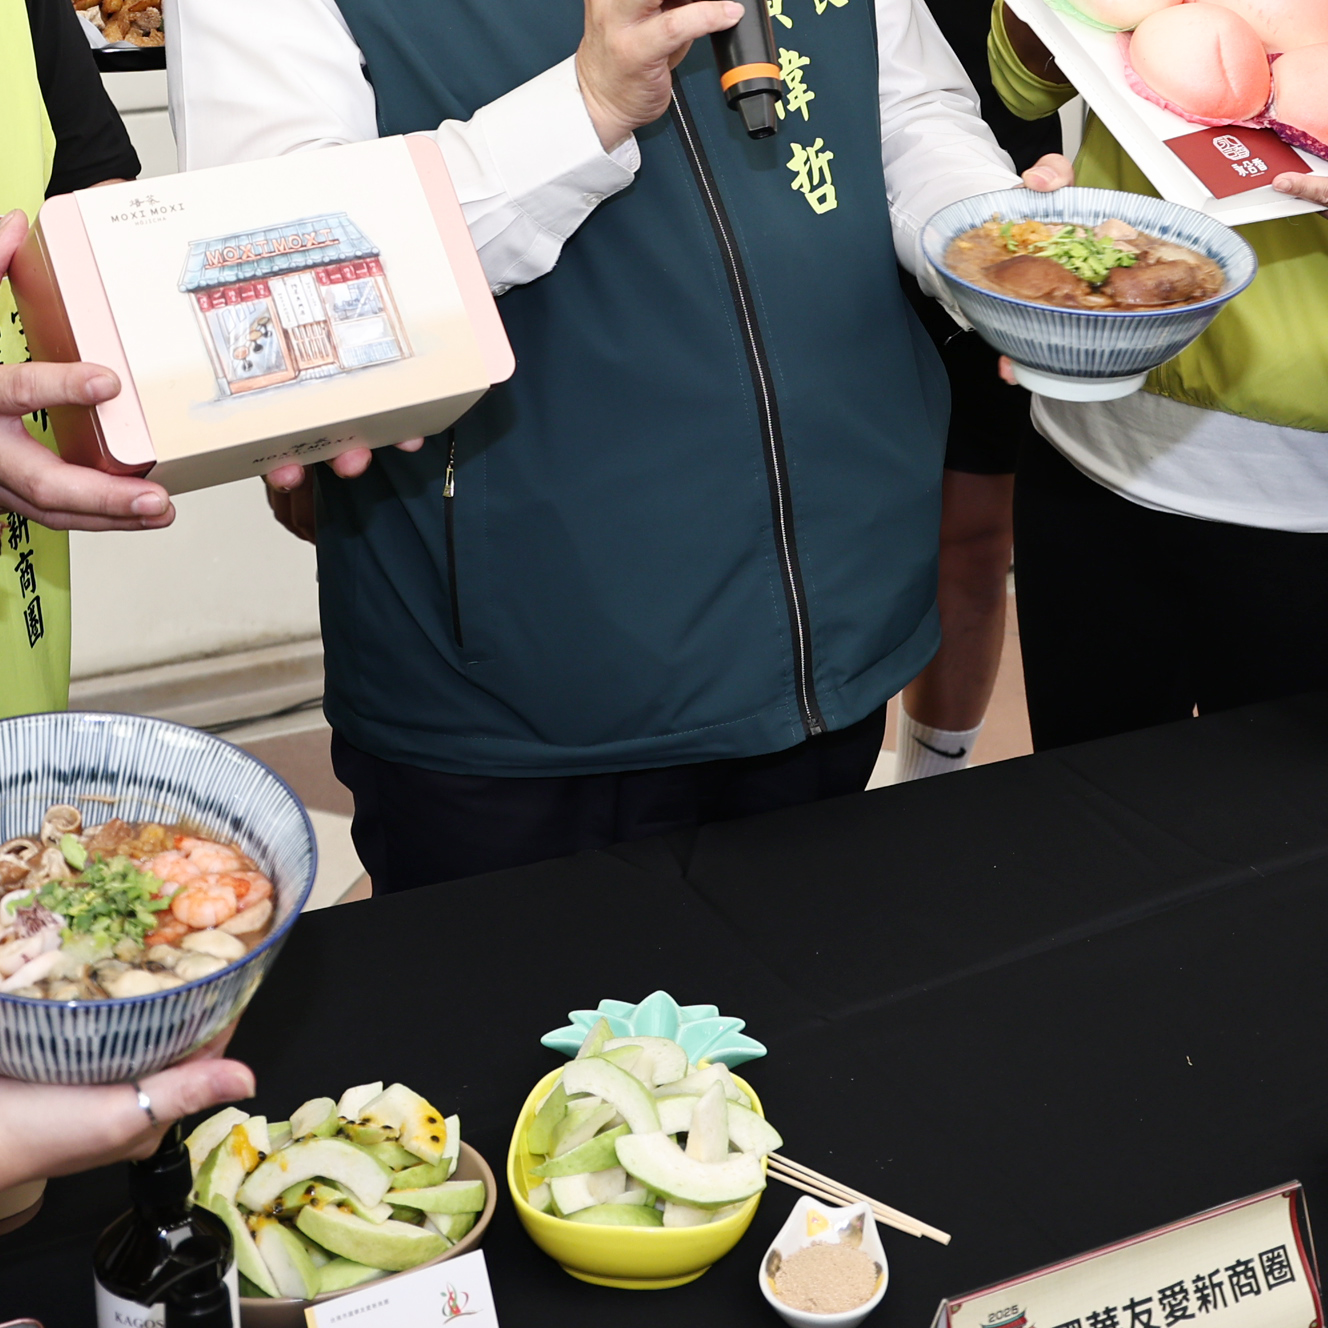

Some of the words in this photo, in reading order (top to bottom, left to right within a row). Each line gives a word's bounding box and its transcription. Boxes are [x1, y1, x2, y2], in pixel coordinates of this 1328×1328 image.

[110, 210, 146, 223] MOXI
[150, 203, 185, 216] MOXI
[988, 1305, 1020, 1323] 2025
